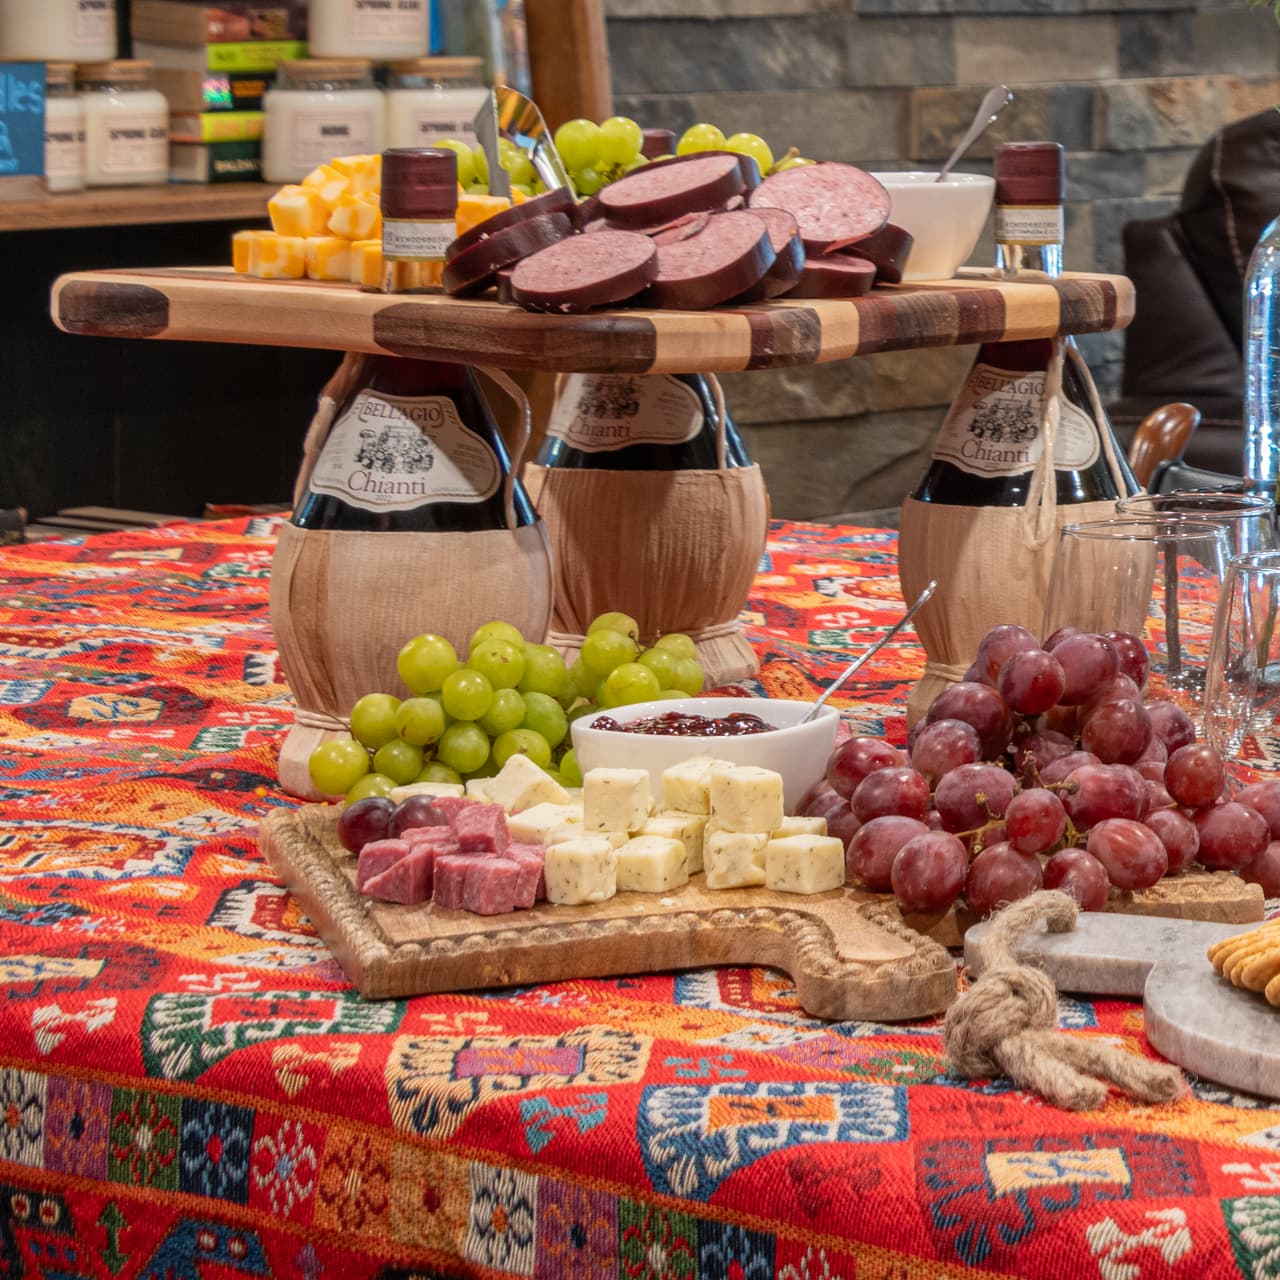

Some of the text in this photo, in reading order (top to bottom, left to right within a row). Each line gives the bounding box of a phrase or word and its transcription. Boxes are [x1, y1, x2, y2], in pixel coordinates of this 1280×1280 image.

[568, 416, 631, 438] Chianti
[960, 439, 1030, 463] Chianti
[348, 470, 427, 495] Chianti
